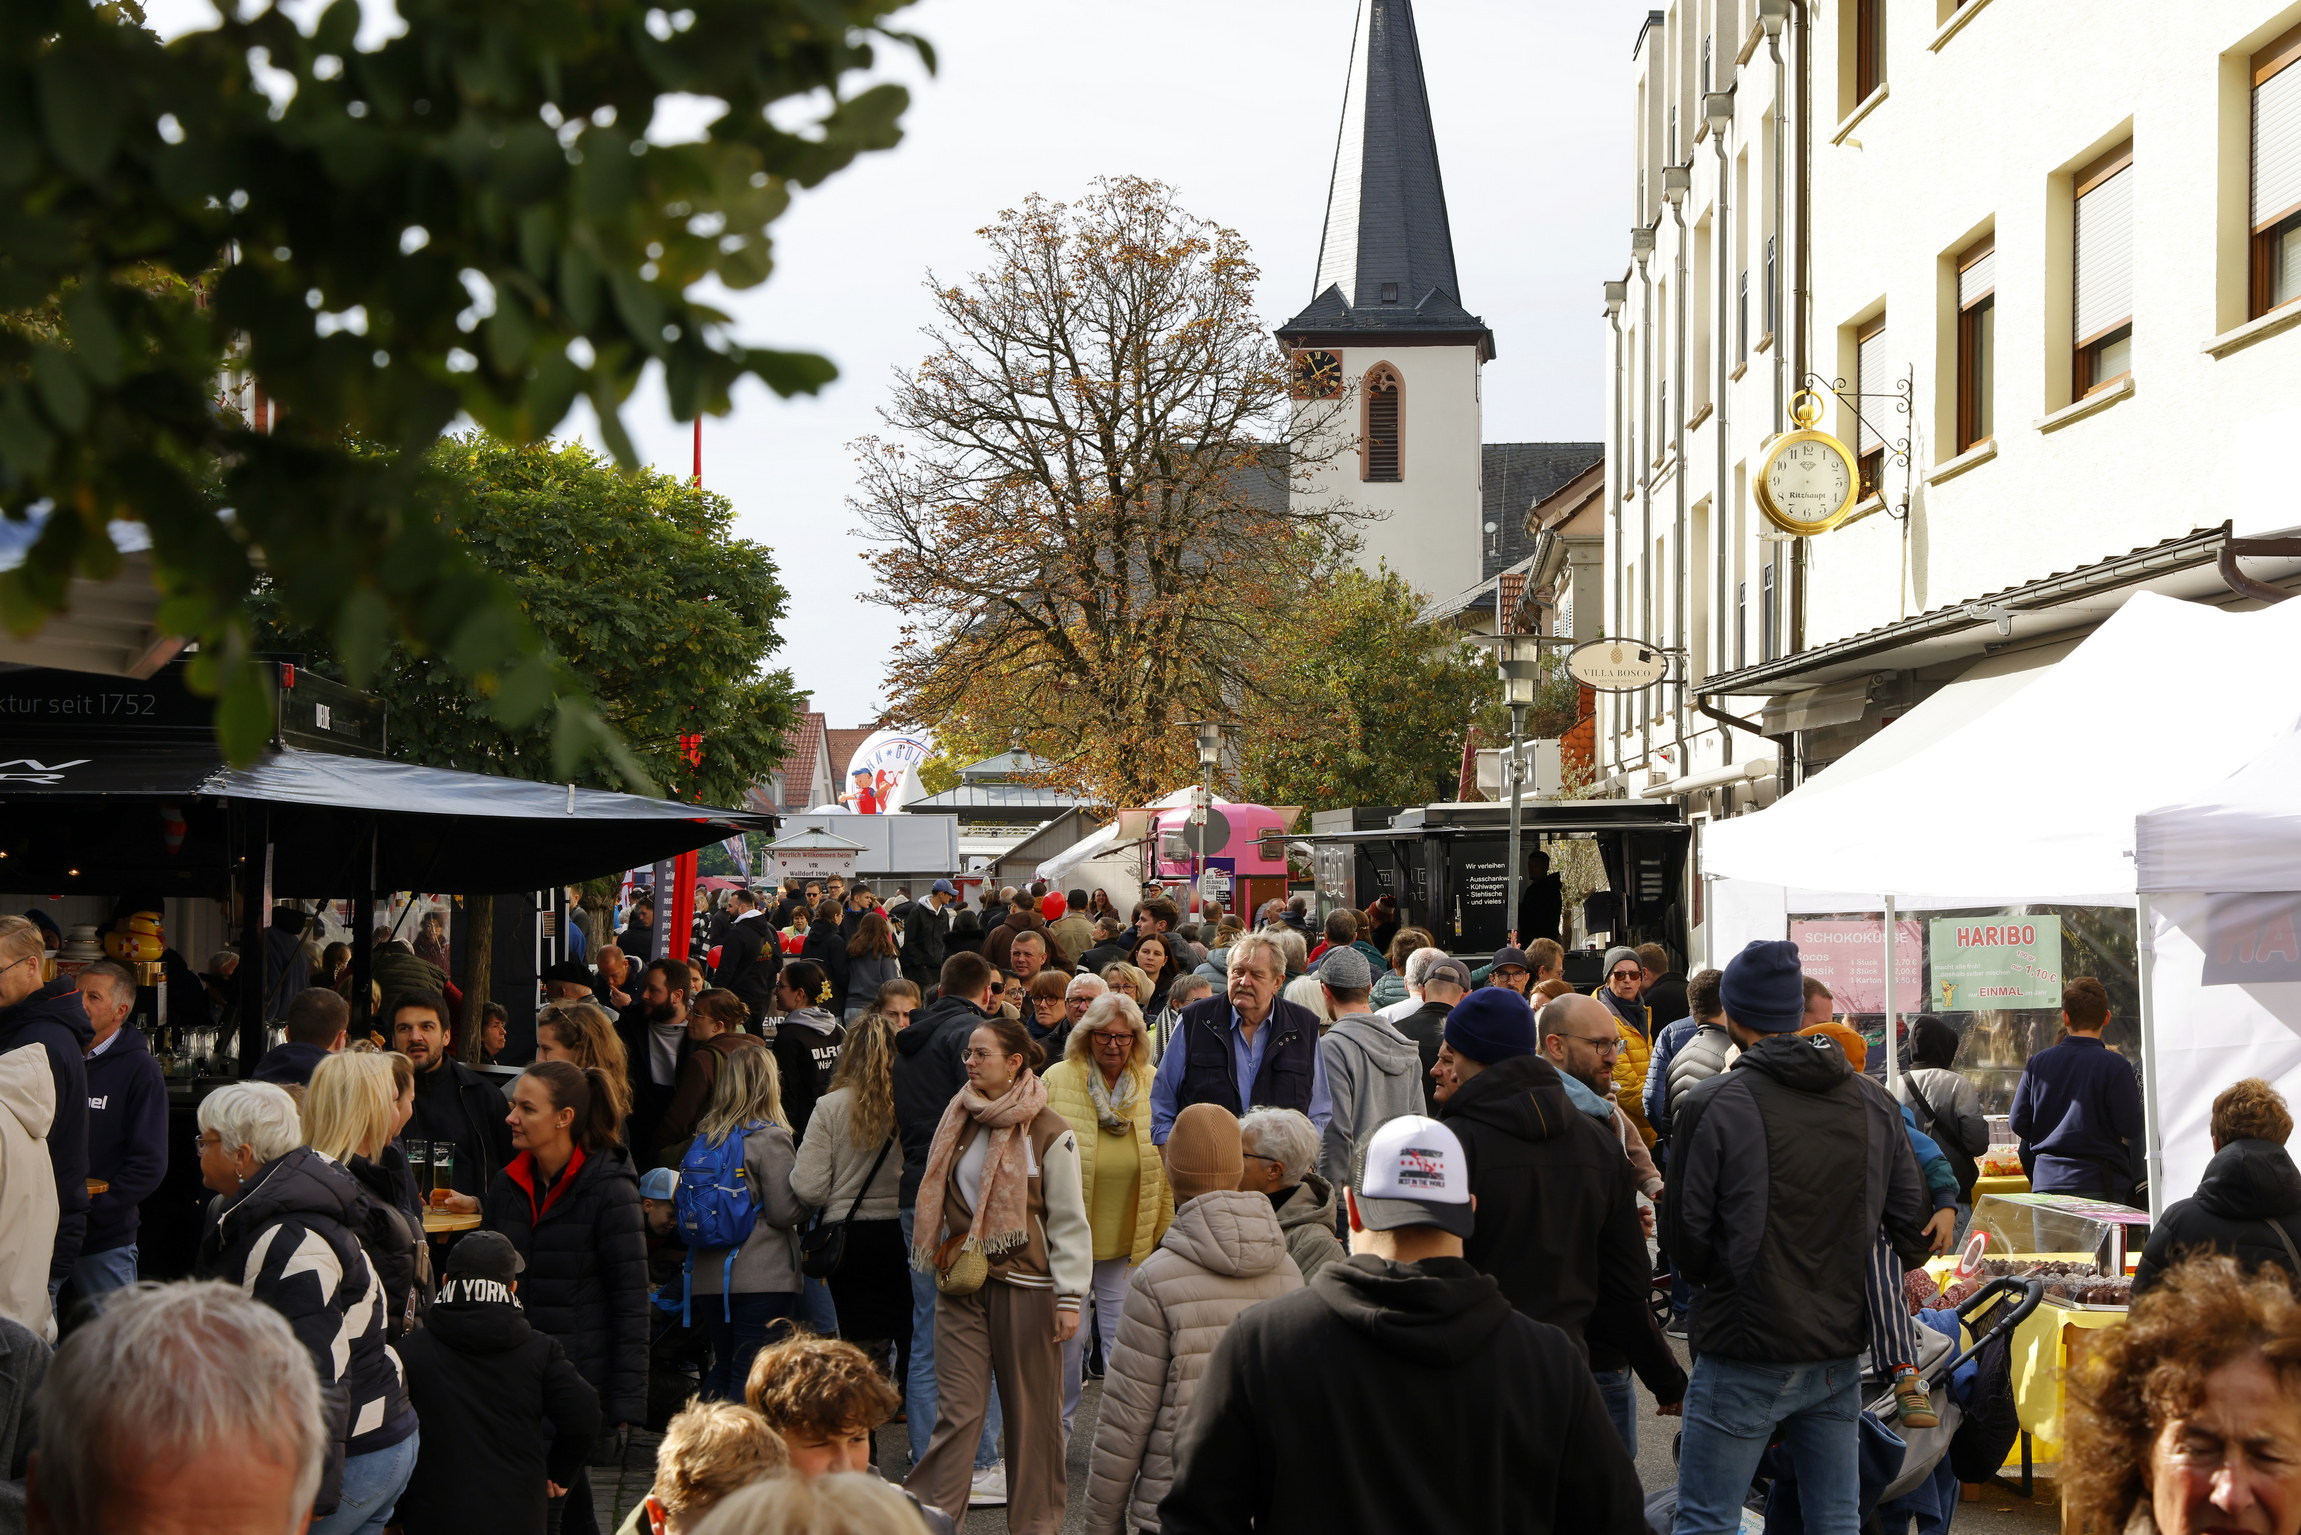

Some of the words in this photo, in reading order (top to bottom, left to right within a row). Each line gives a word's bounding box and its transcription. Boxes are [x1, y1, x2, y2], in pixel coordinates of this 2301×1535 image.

[1803, 445, 1814, 456] 12
[1777, 461, 1787, 471] 10
[1773, 476, 1780, 486] 9
[1777, 492, 1785, 502] 8
[1789, 491, 1826, 499] Ritzhaupt
[1803, 508, 1811, 518] 6
[1584, 669, 1614, 677] VILLA
[1617, 669, 1651, 677] BOSCO
[49, 695, 93, 714] seit
[100, 693, 156, 715] 1752
[802, 851, 836, 859] Willkommen
[1470, 883, 1505, 891] Kühlwagen
[1956, 924, 2036, 947] HARIBO
[1856, 958, 1878, 966] Stück
[1801, 965, 1834, 975] lassik
[1856, 967, 1878, 975] Stück
[2025, 964, 2048, 980] 1,10
[2049, 973, 2057, 983] €
[1979, 986, 2024, 997] EINMAL
[461, 1279, 510, 1303] YORK
